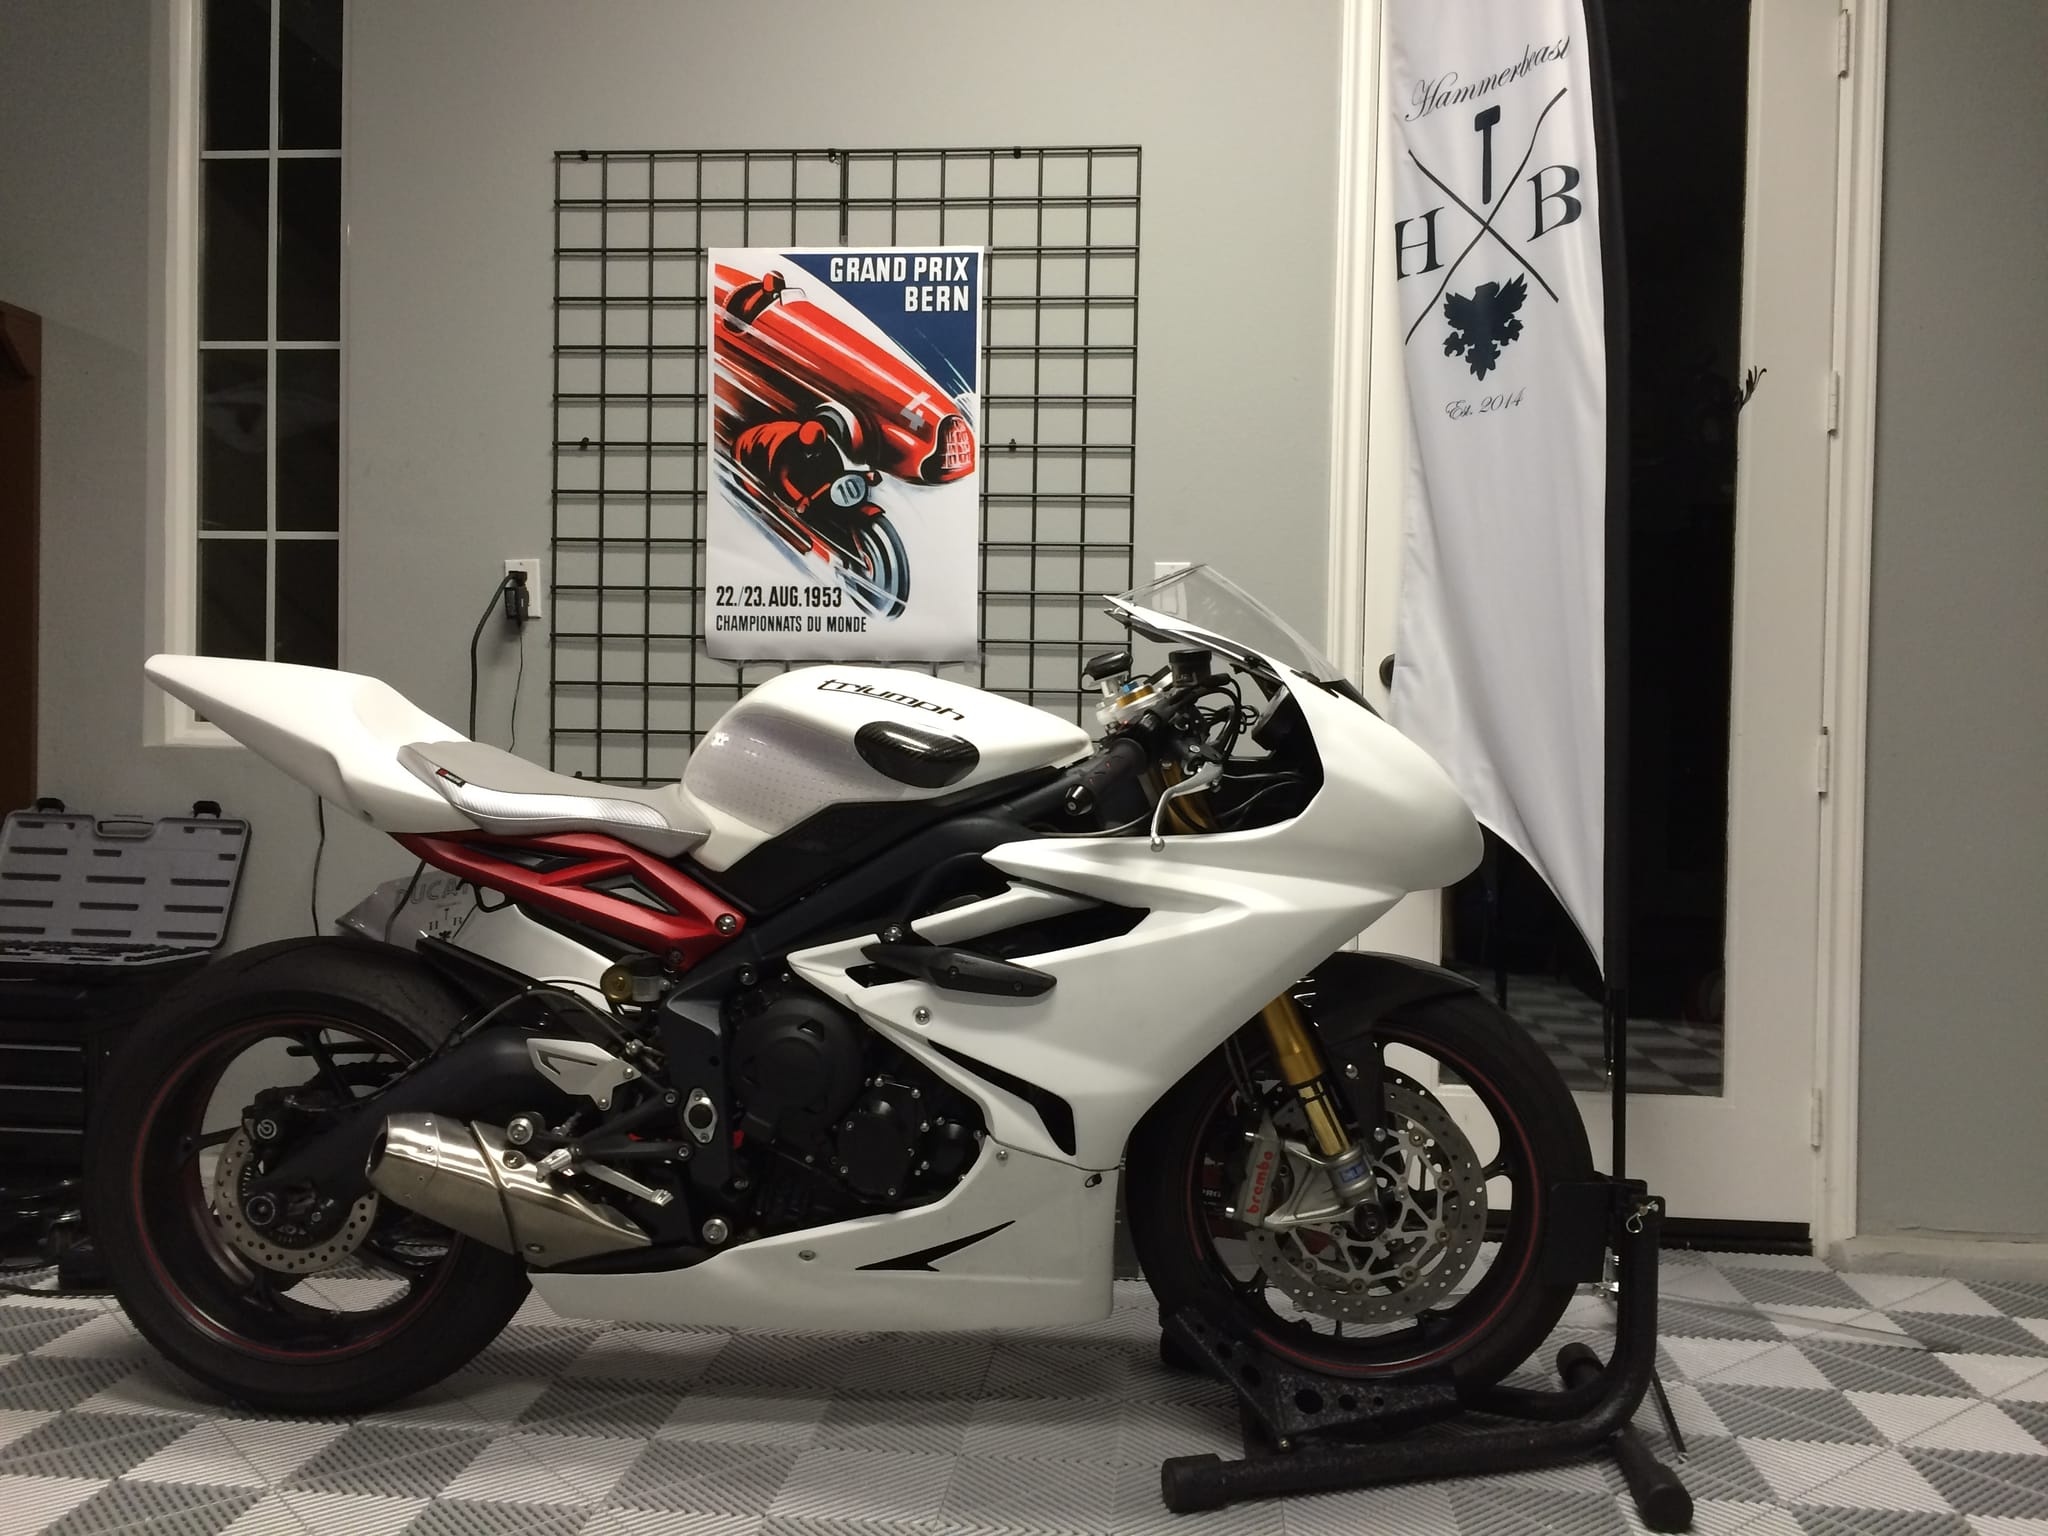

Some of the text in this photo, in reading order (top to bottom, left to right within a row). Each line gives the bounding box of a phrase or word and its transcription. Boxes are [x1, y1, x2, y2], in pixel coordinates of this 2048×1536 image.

[1404, 36, 1570, 122] Hammerbeast
[1394, 165, 1582, 281] H B
[830, 256, 970, 282] GRAND PRIX
[905, 285, 969, 312] BERN
[901, 391, 931, 430] 4
[1479, 387, 1527, 413] 2014
[837, 479, 861, 504] 10
[716, 614, 867, 633] CHAMPIONNATS DU MONDE
[817, 679, 965, 721] triumph
[1246, 1151, 1274, 1214] brembo
